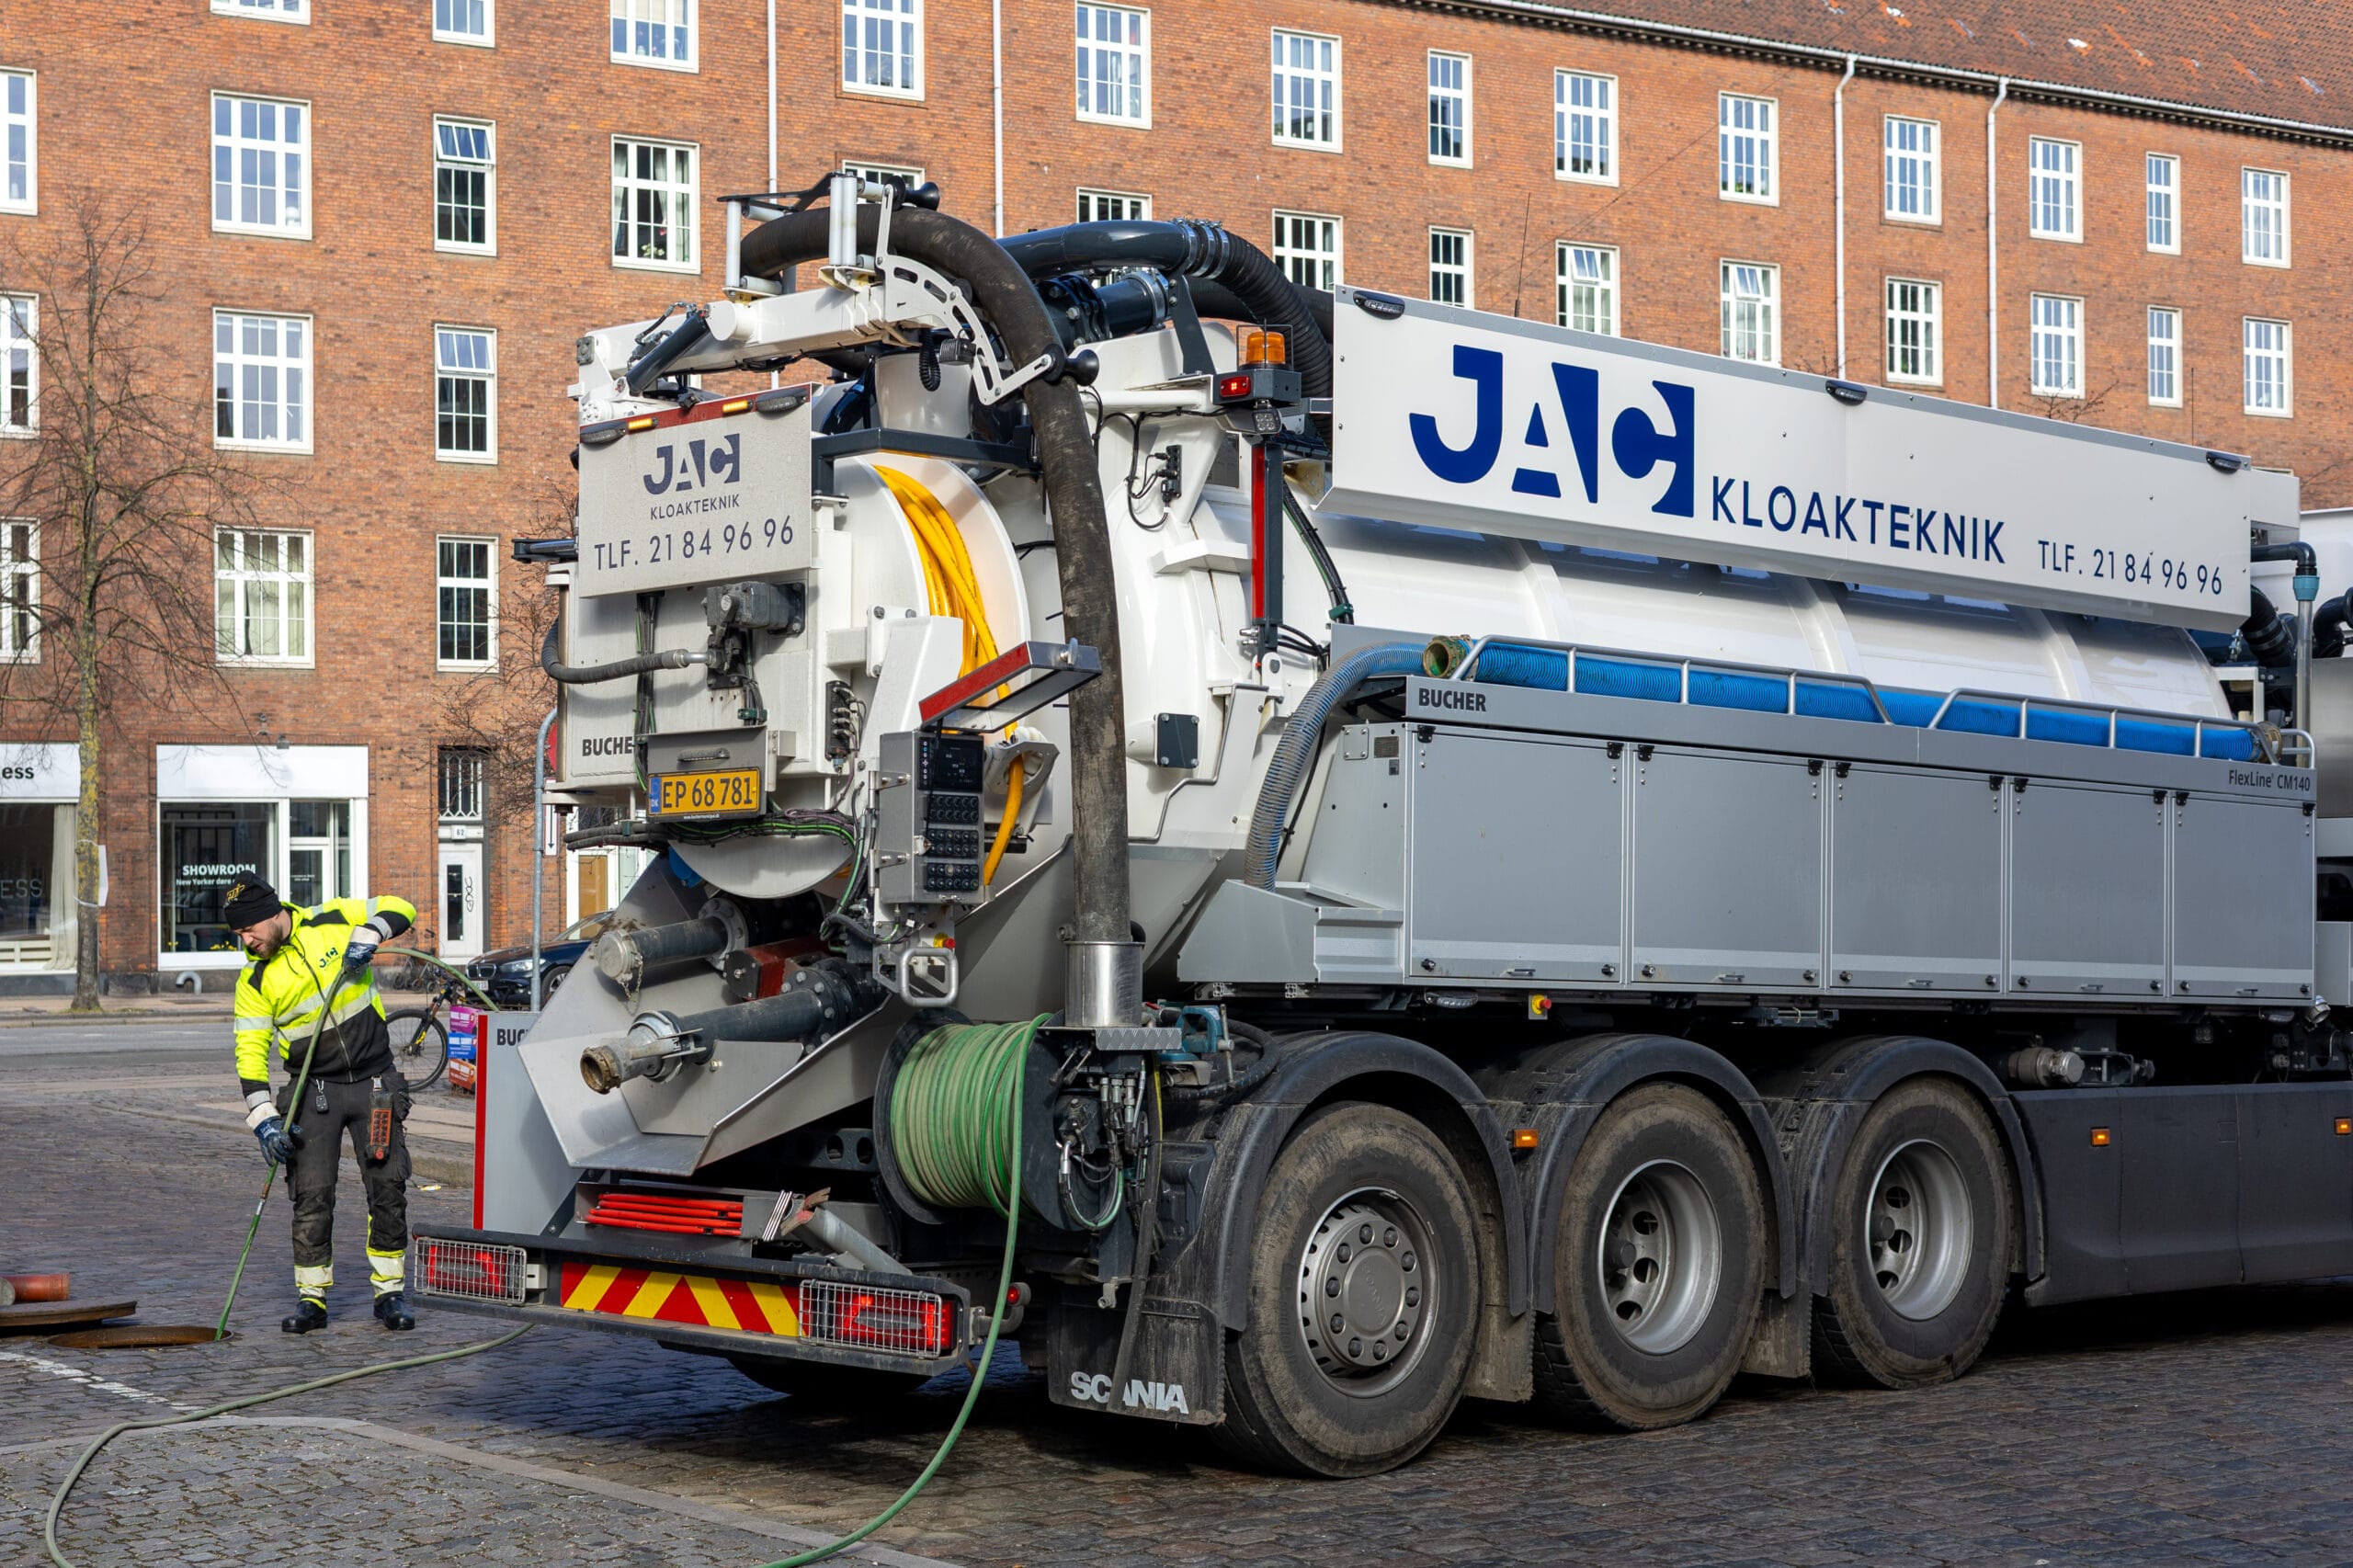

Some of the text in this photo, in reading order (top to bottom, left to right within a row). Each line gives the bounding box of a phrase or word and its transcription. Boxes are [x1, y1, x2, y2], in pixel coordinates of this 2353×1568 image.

[1409, 344, 1695, 517] JAC
[643, 433, 740, 495] JAC
[650, 494, 740, 521] KLOAKTEKNIK
[1712, 475, 2006, 563] KLOAKTEKNIK
[595, 540, 639, 570] TLF.
[2038, 540, 2083, 574] TLF.
[1418, 687, 1486, 711] BUCHER
[663, 777, 753, 808] EP 68 781
[2277, 775, 2311, 791] CM140
[651, 799, 660, 807] DK
[182, 864, 256, 876] SHOWROOM
